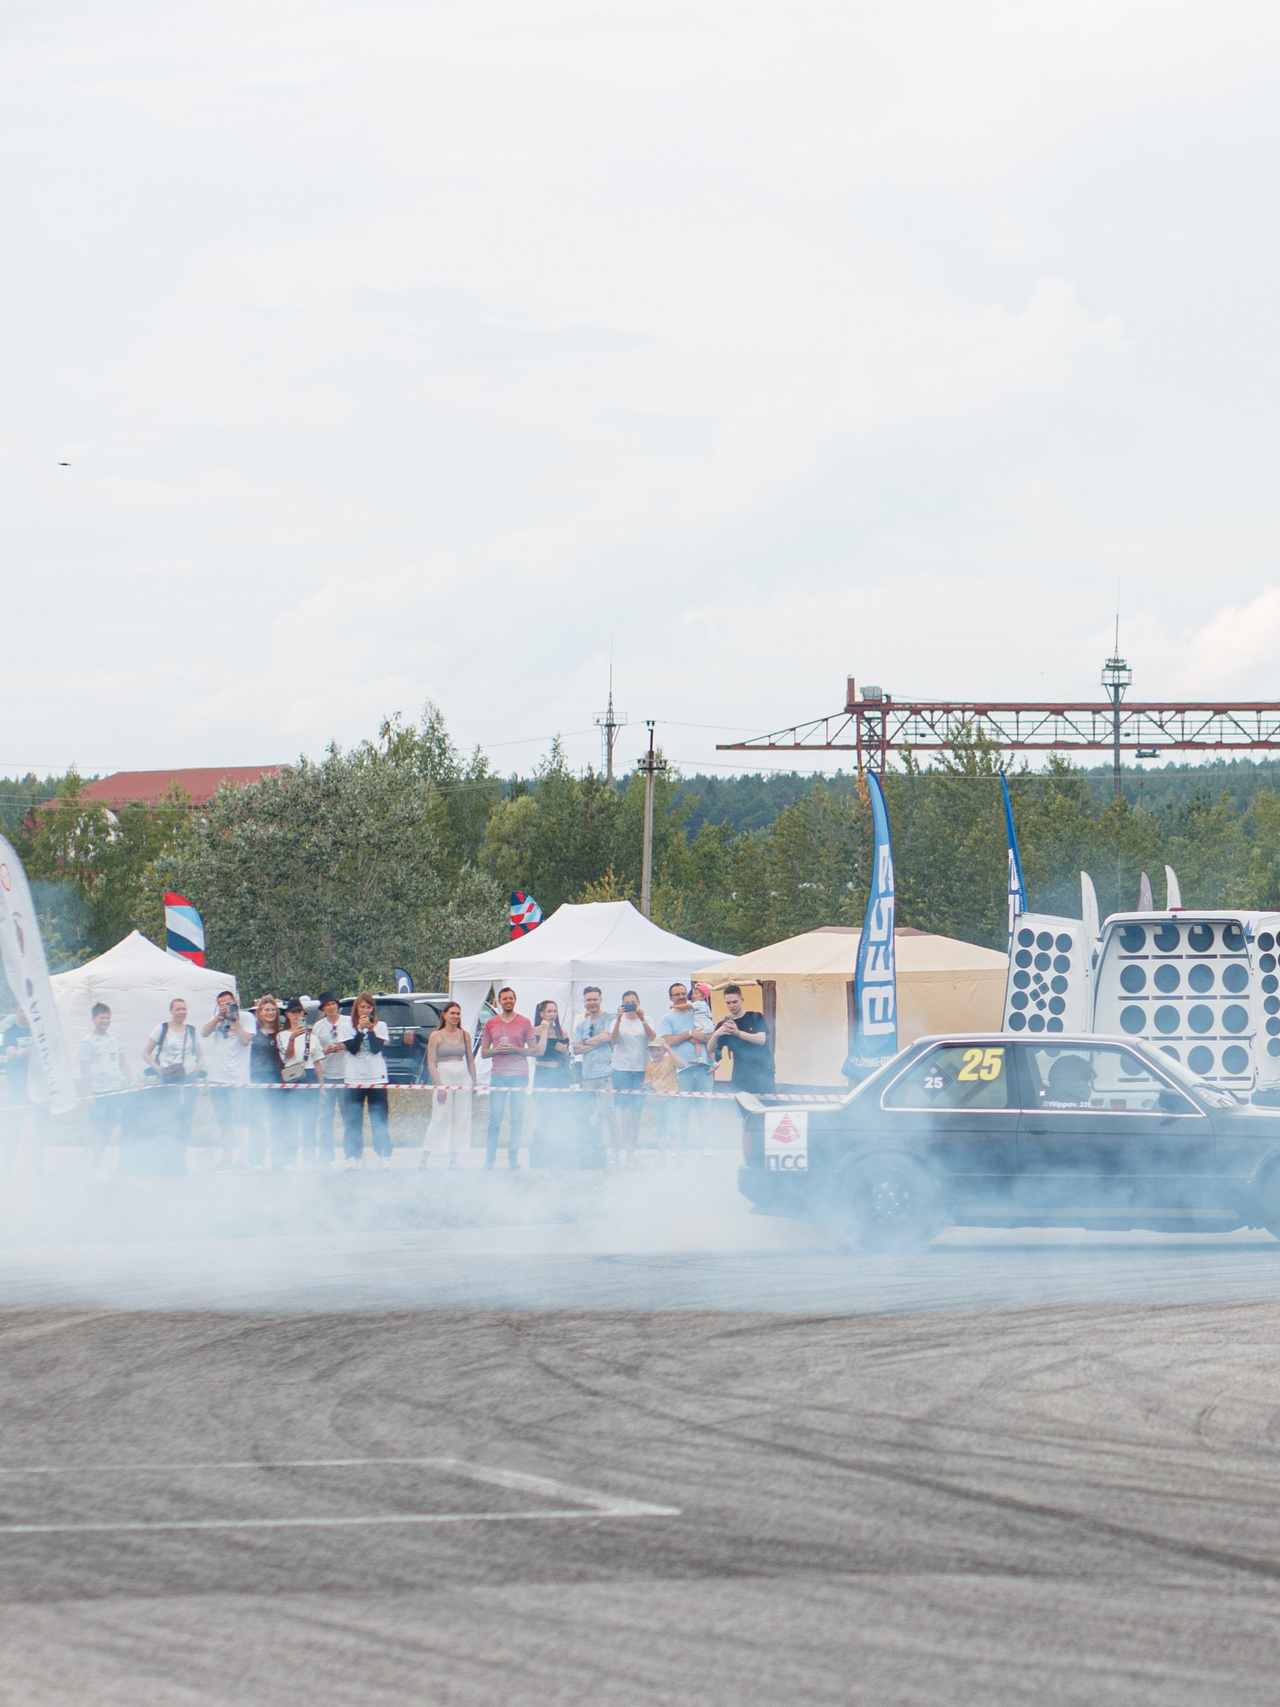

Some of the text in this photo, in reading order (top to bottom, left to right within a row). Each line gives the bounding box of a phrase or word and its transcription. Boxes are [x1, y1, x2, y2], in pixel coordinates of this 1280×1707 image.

[957, 1047, 1005, 1082] 25
[924, 1076, 944, 1089] 25
[765, 1154, 806, 1170] ПСС
